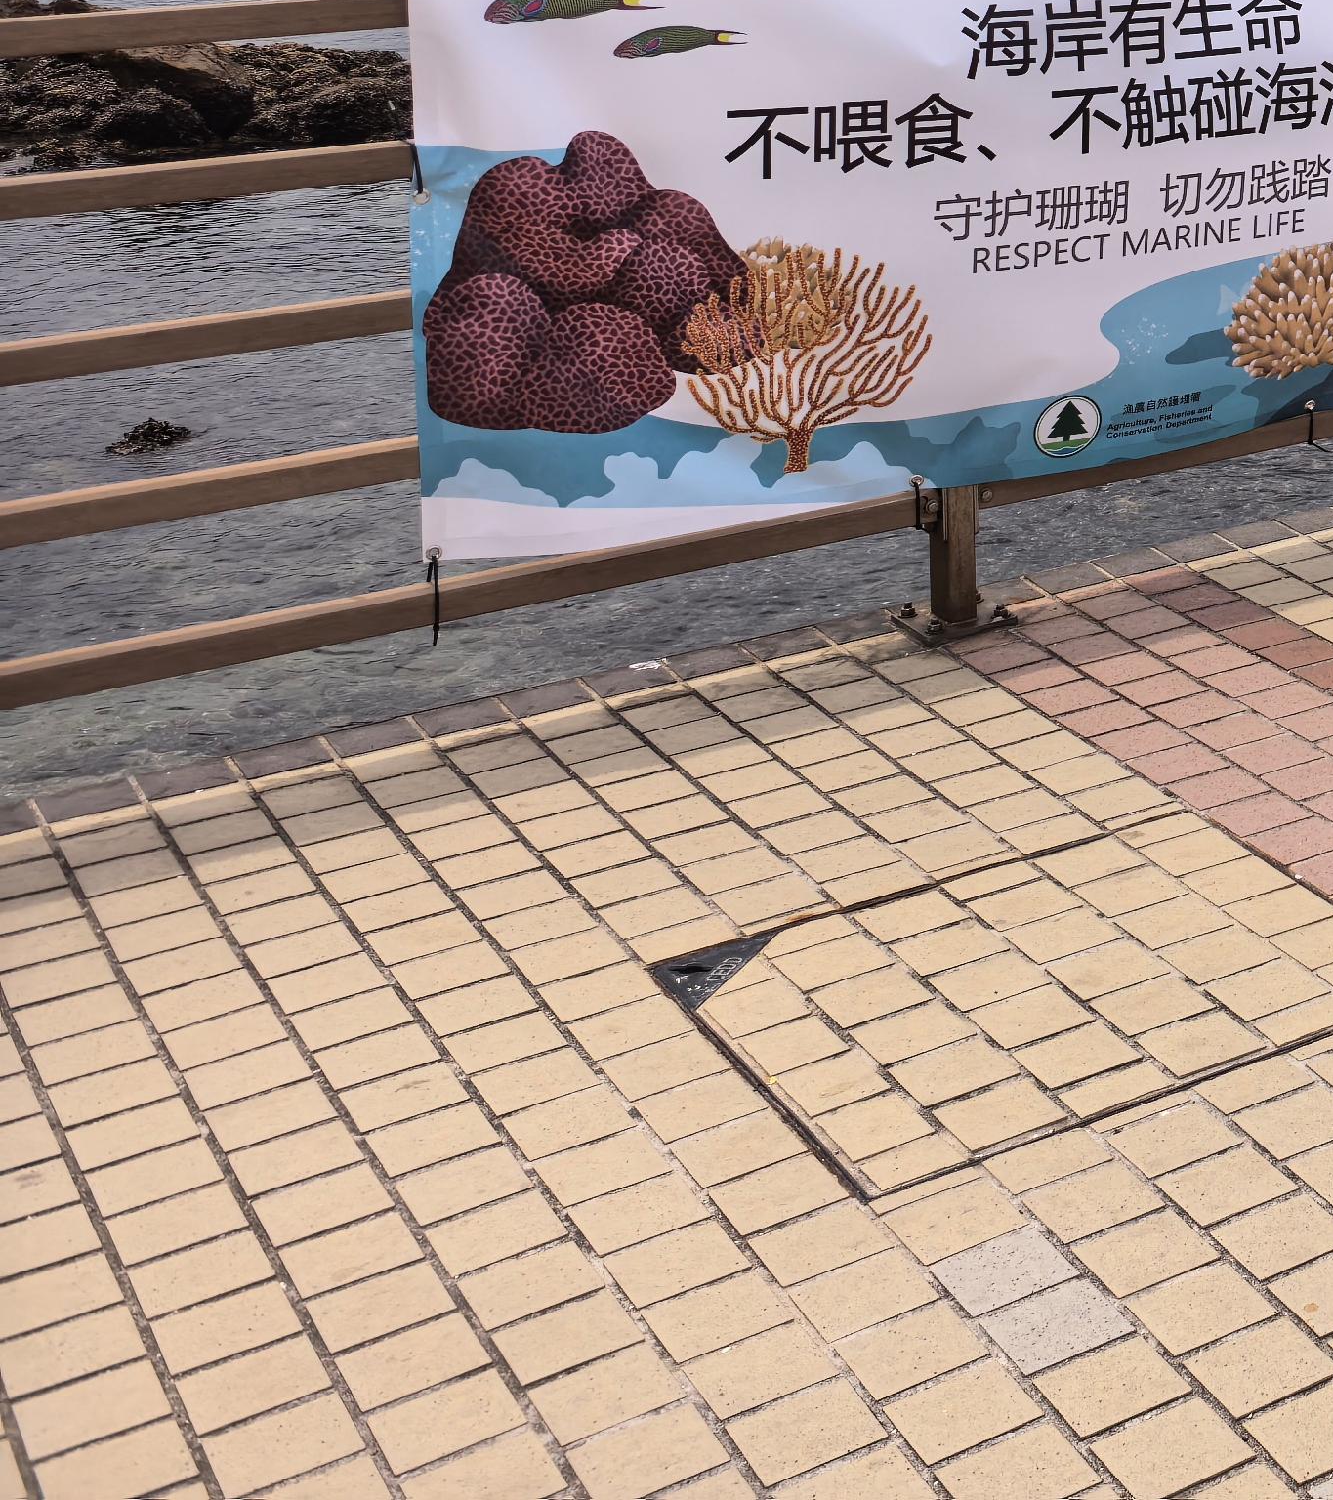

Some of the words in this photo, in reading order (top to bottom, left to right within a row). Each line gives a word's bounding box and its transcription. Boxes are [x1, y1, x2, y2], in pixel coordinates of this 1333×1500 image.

[934, 180, 1129, 241] 守护珊瑚
[1160, 154, 1332, 218] 切勿践踏
[973, 234, 1111, 274] RESPECT
[1122, 218, 1241, 257] MARINE
[1253, 209, 1305, 239] LIFE
[1106, 418, 1157, 433] Agriculture,
[1159, 409, 1196, 422] Fisheries
[1196, 405, 1213, 415] and
[1106, 424, 1163, 439] Conservation
[1166, 413, 1212, 430] Department
